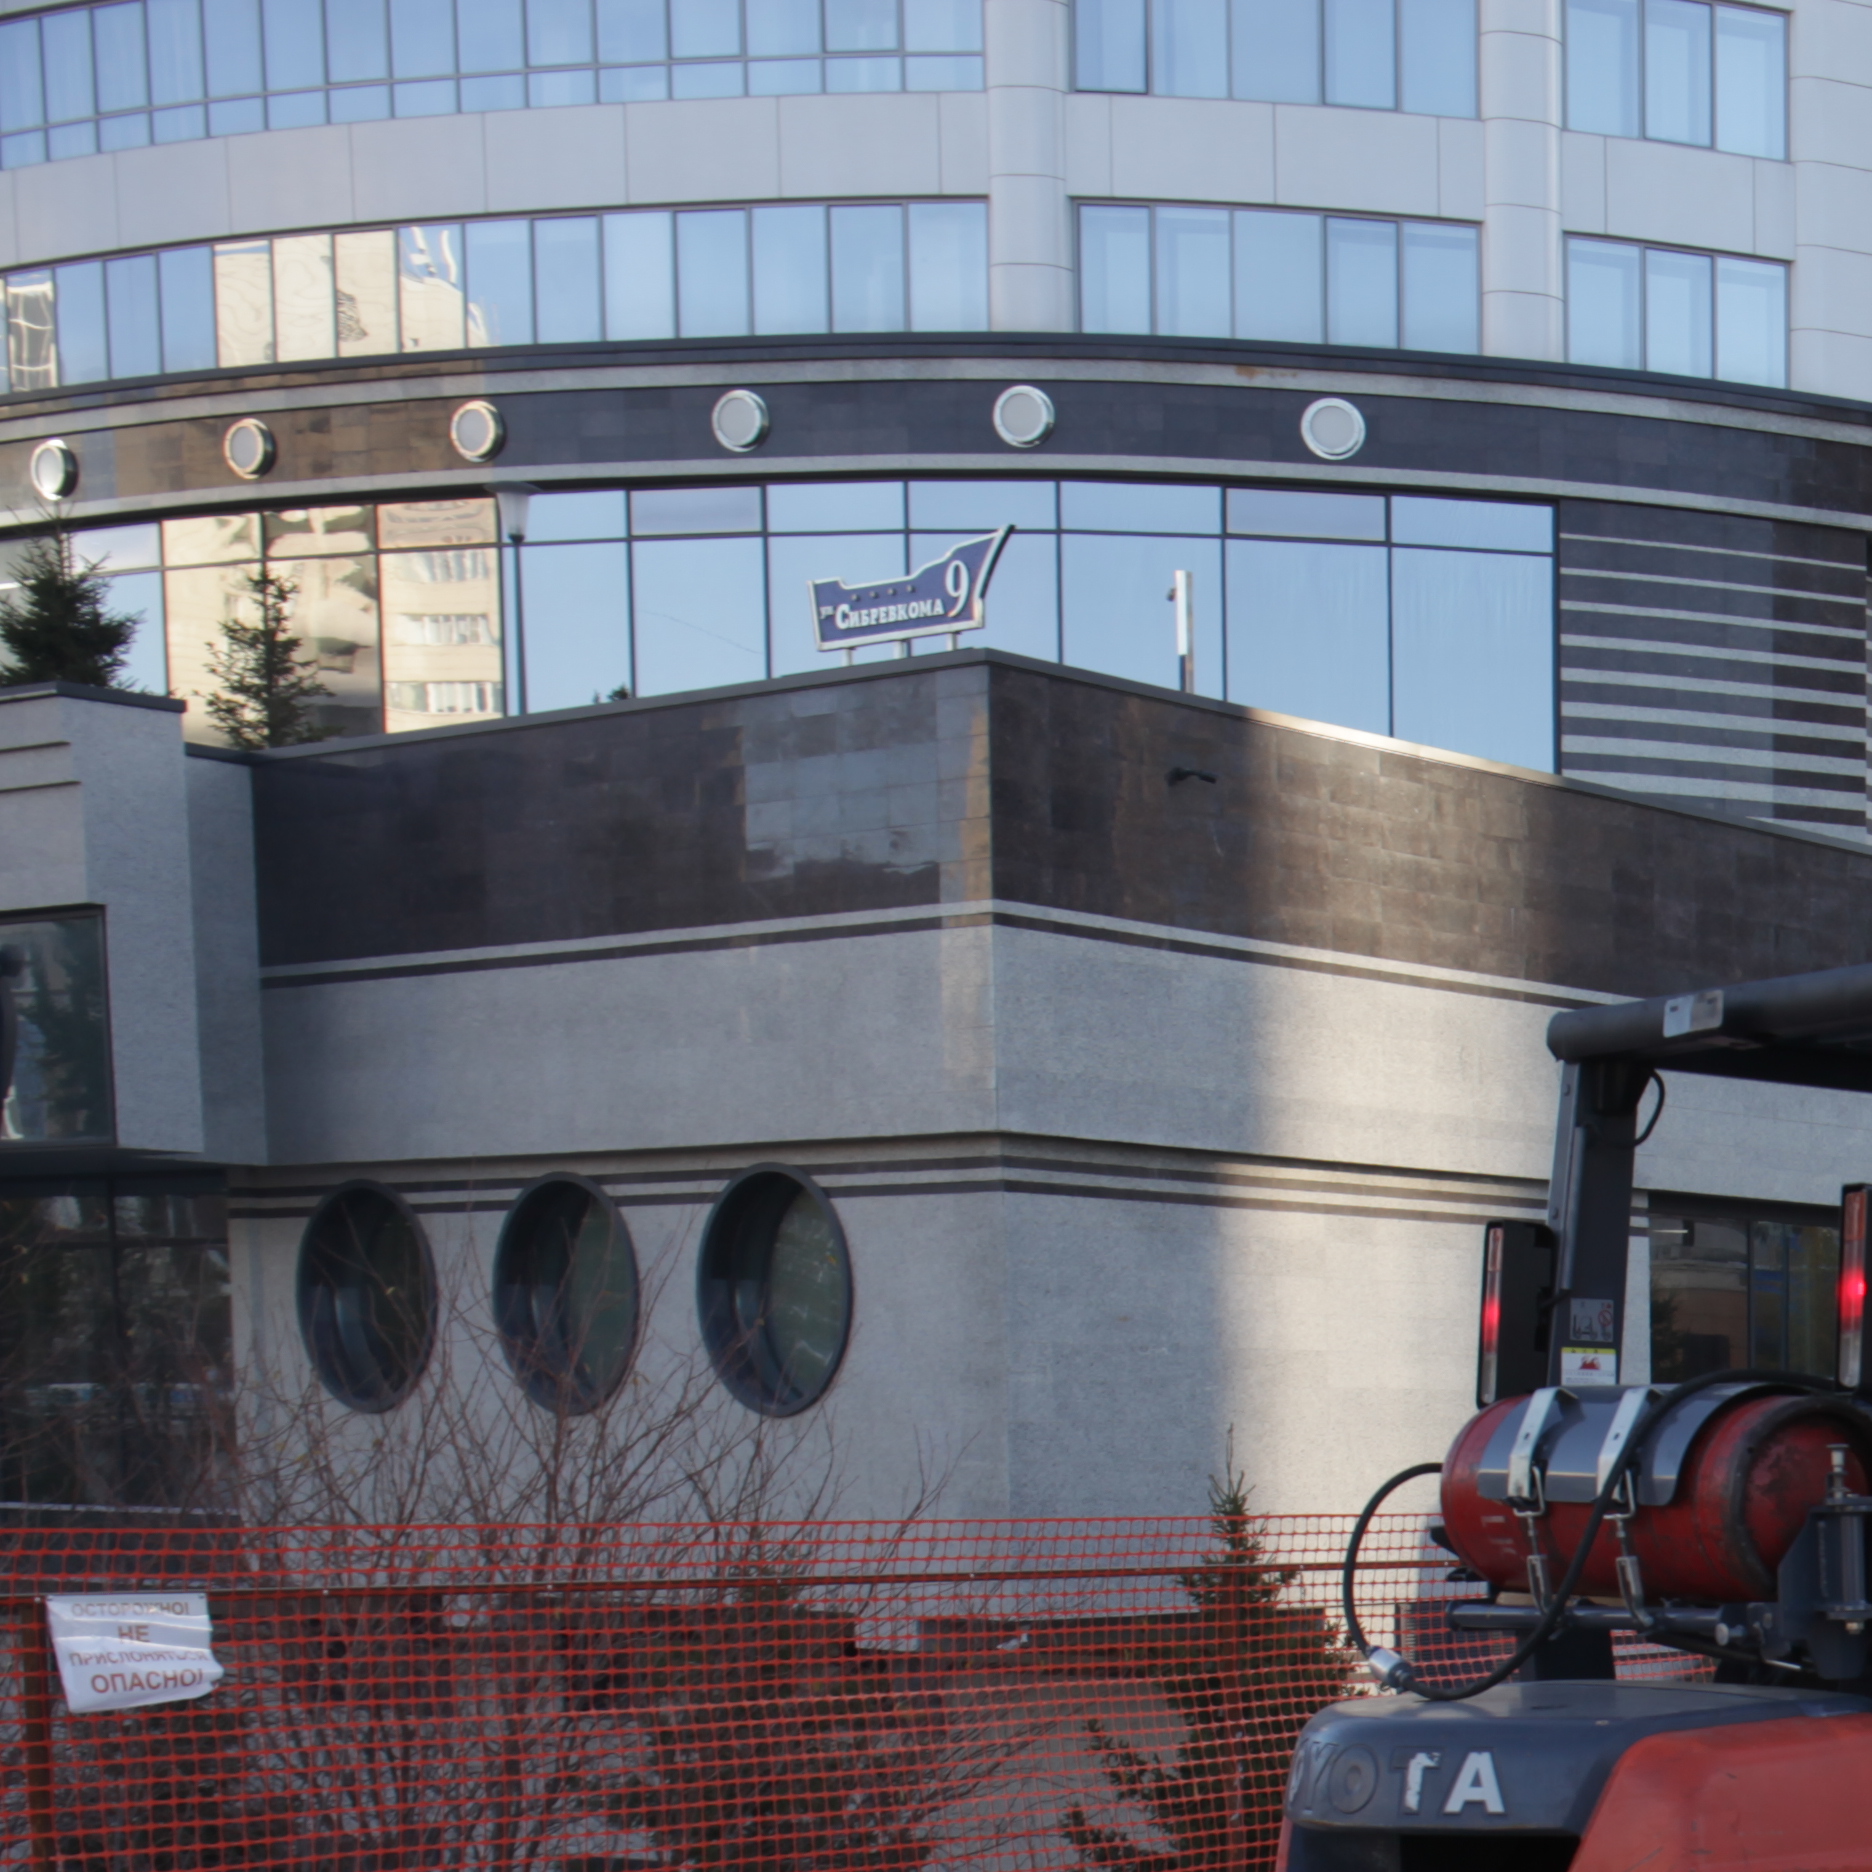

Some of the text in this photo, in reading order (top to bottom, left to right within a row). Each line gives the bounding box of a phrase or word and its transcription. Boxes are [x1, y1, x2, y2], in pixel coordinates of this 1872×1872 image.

[945, 560, 970, 618] 9
[117, 1625, 150, 1644] НЕ
[90, 1668, 203, 1694] ОПАСНО!
